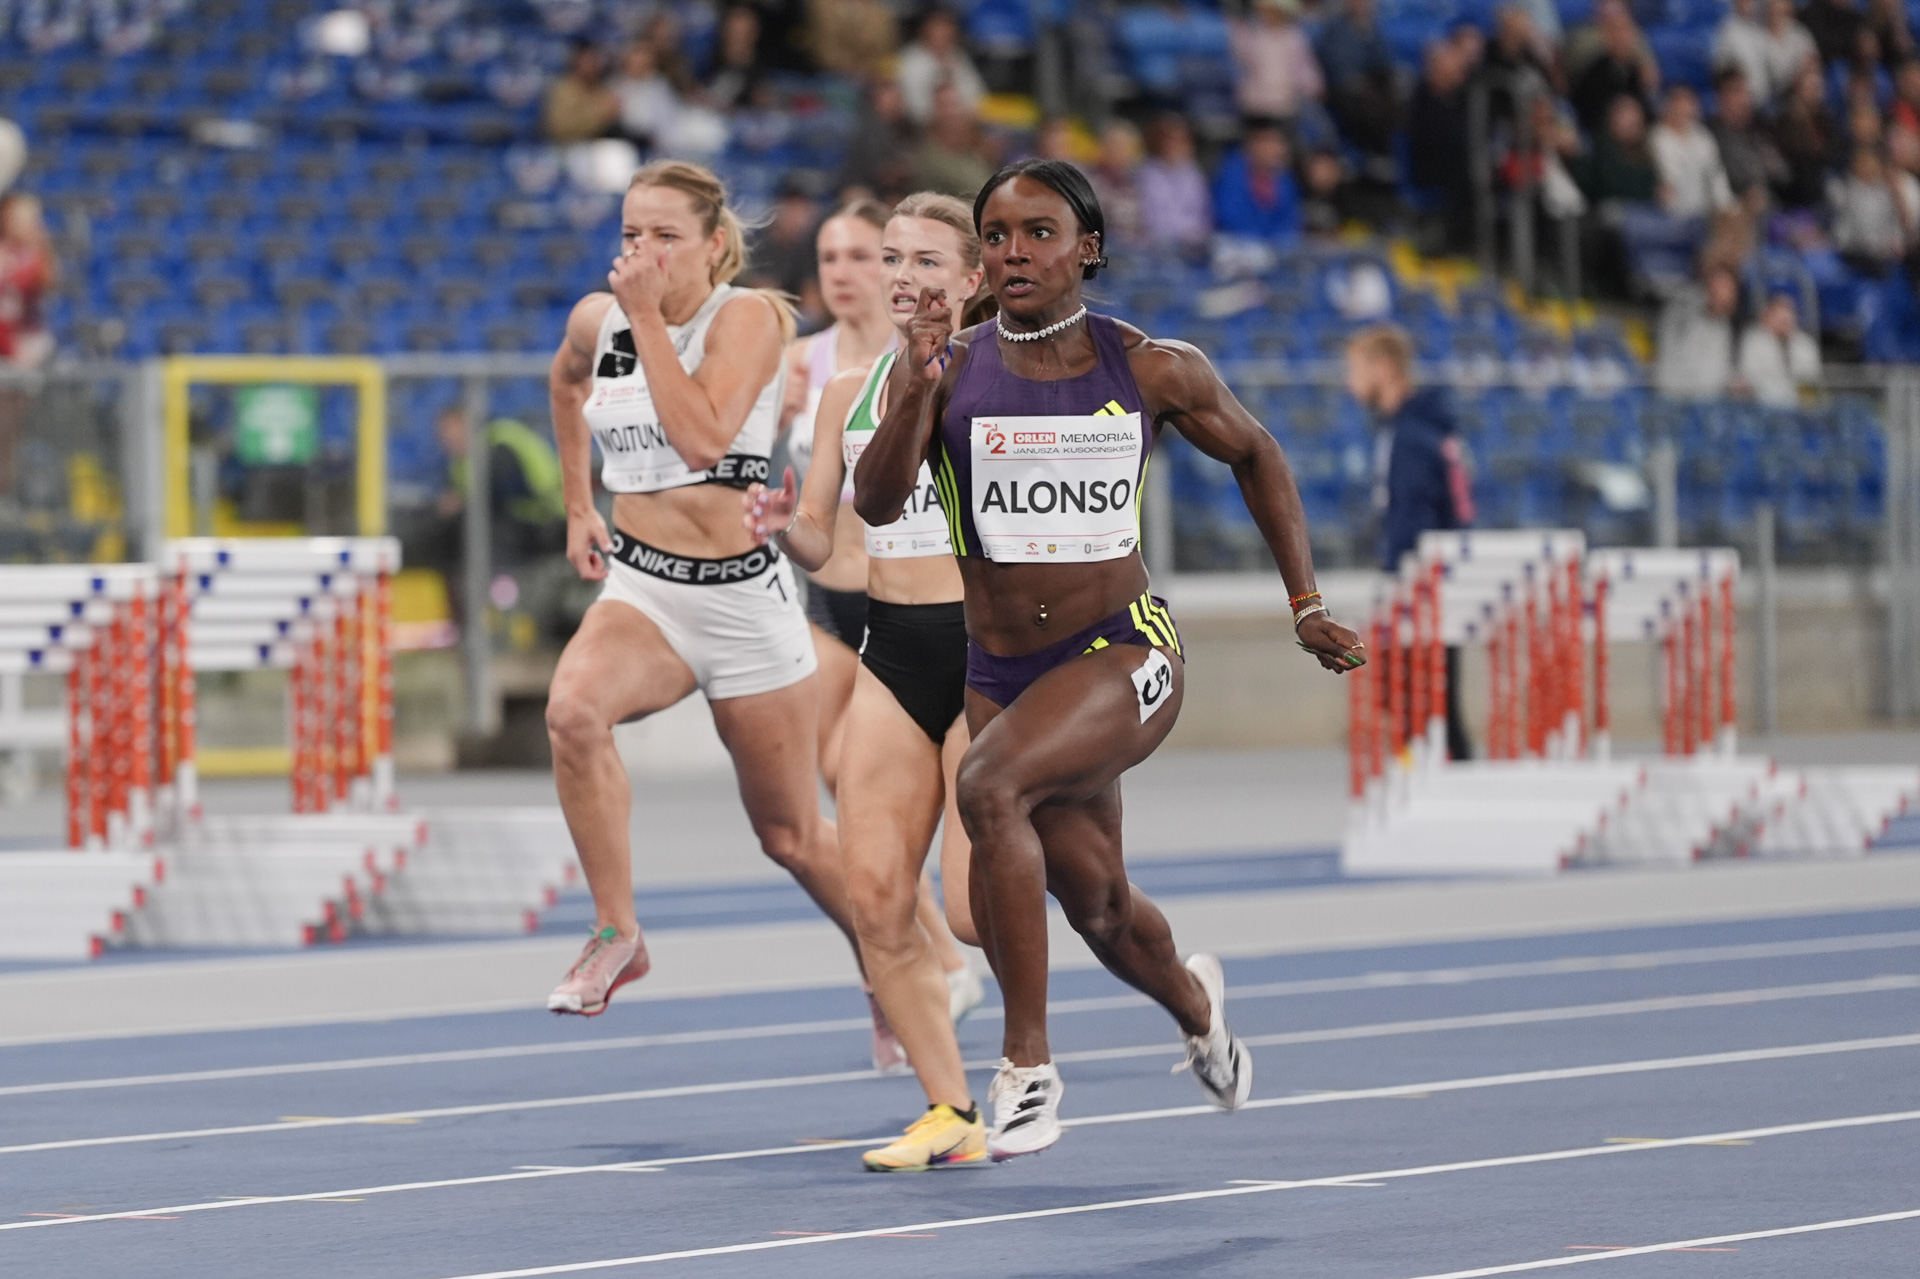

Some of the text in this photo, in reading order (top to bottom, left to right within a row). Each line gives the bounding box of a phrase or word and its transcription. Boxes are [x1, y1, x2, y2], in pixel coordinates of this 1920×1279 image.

[1014, 431, 1136, 443] ORLEN MEMORIAŁ
[1063, 444, 1137, 454] KUSOCIŃSKIEGO
[902, 483, 944, 520] TA
[980, 478, 1130, 514] ALONSO
[629, 544, 694, 579] NIKE
[696, 552, 767, 581] PRO
[1142, 663, 1169, 706] 5
